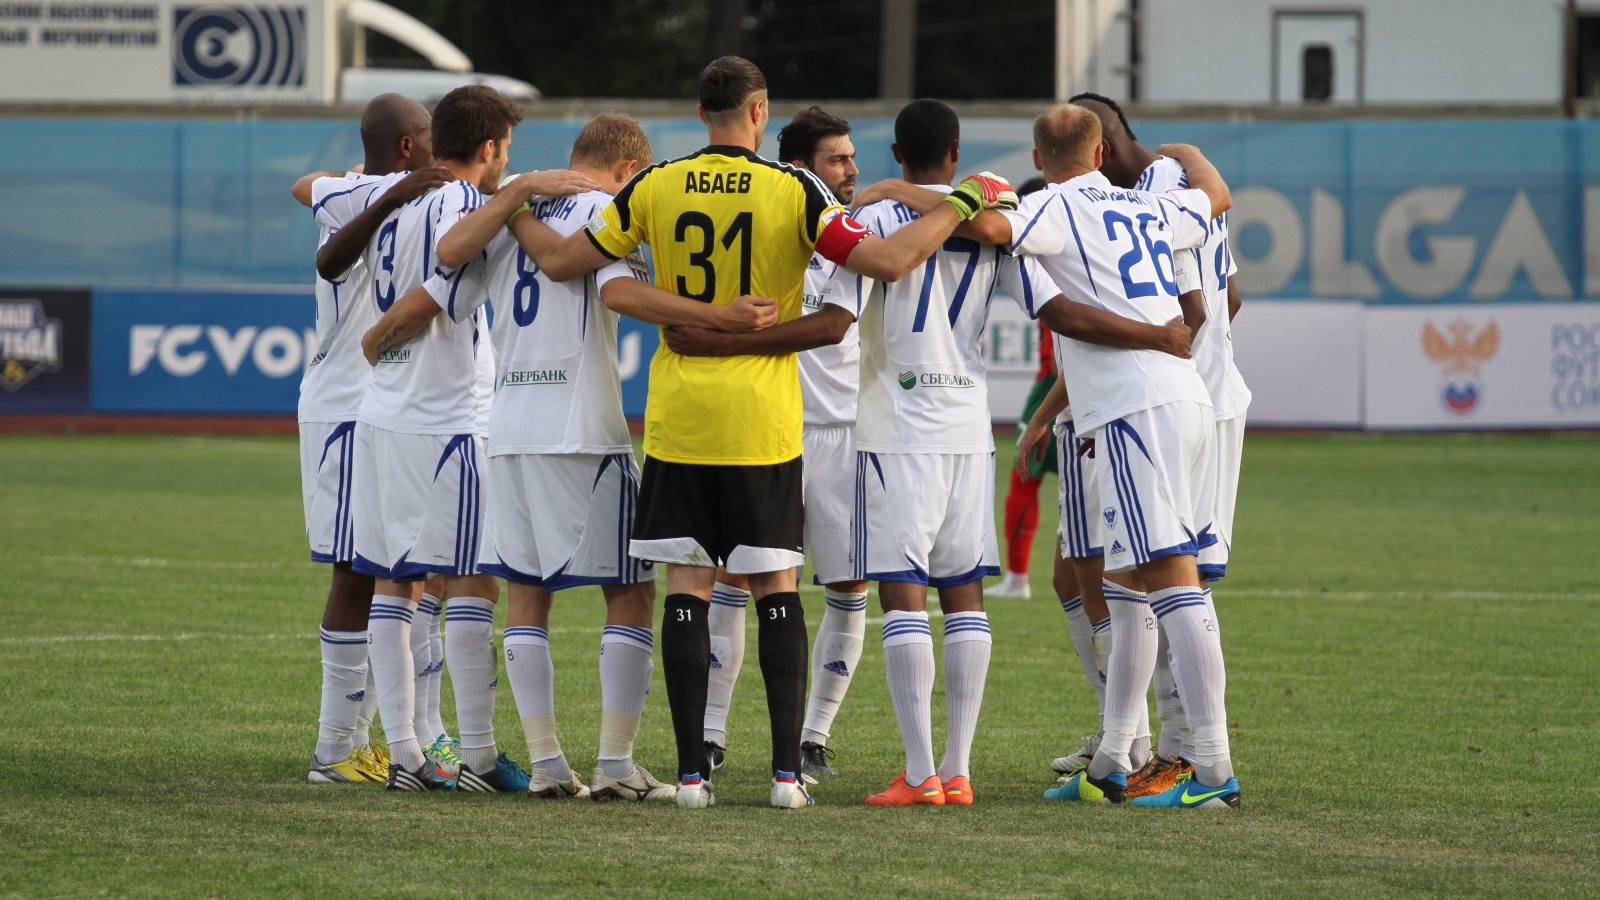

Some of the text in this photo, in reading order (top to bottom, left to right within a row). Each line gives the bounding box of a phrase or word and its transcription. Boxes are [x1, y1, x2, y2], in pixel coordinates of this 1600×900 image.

[685, 171, 752, 194] АБАЕВ
[675, 211, 753, 304] 31
[1103, 210, 1177, 300] 26
[376, 218, 399, 314] 3
[513, 244, 540, 328] 8
[505, 370, 567, 383] СБЕРБАНК
[920, 372, 975, 386] СБЕРБАНК
[676, 608, 692, 622] 31
[769, 606, 786, 620] 31
[507, 649, 514, 661] 8
